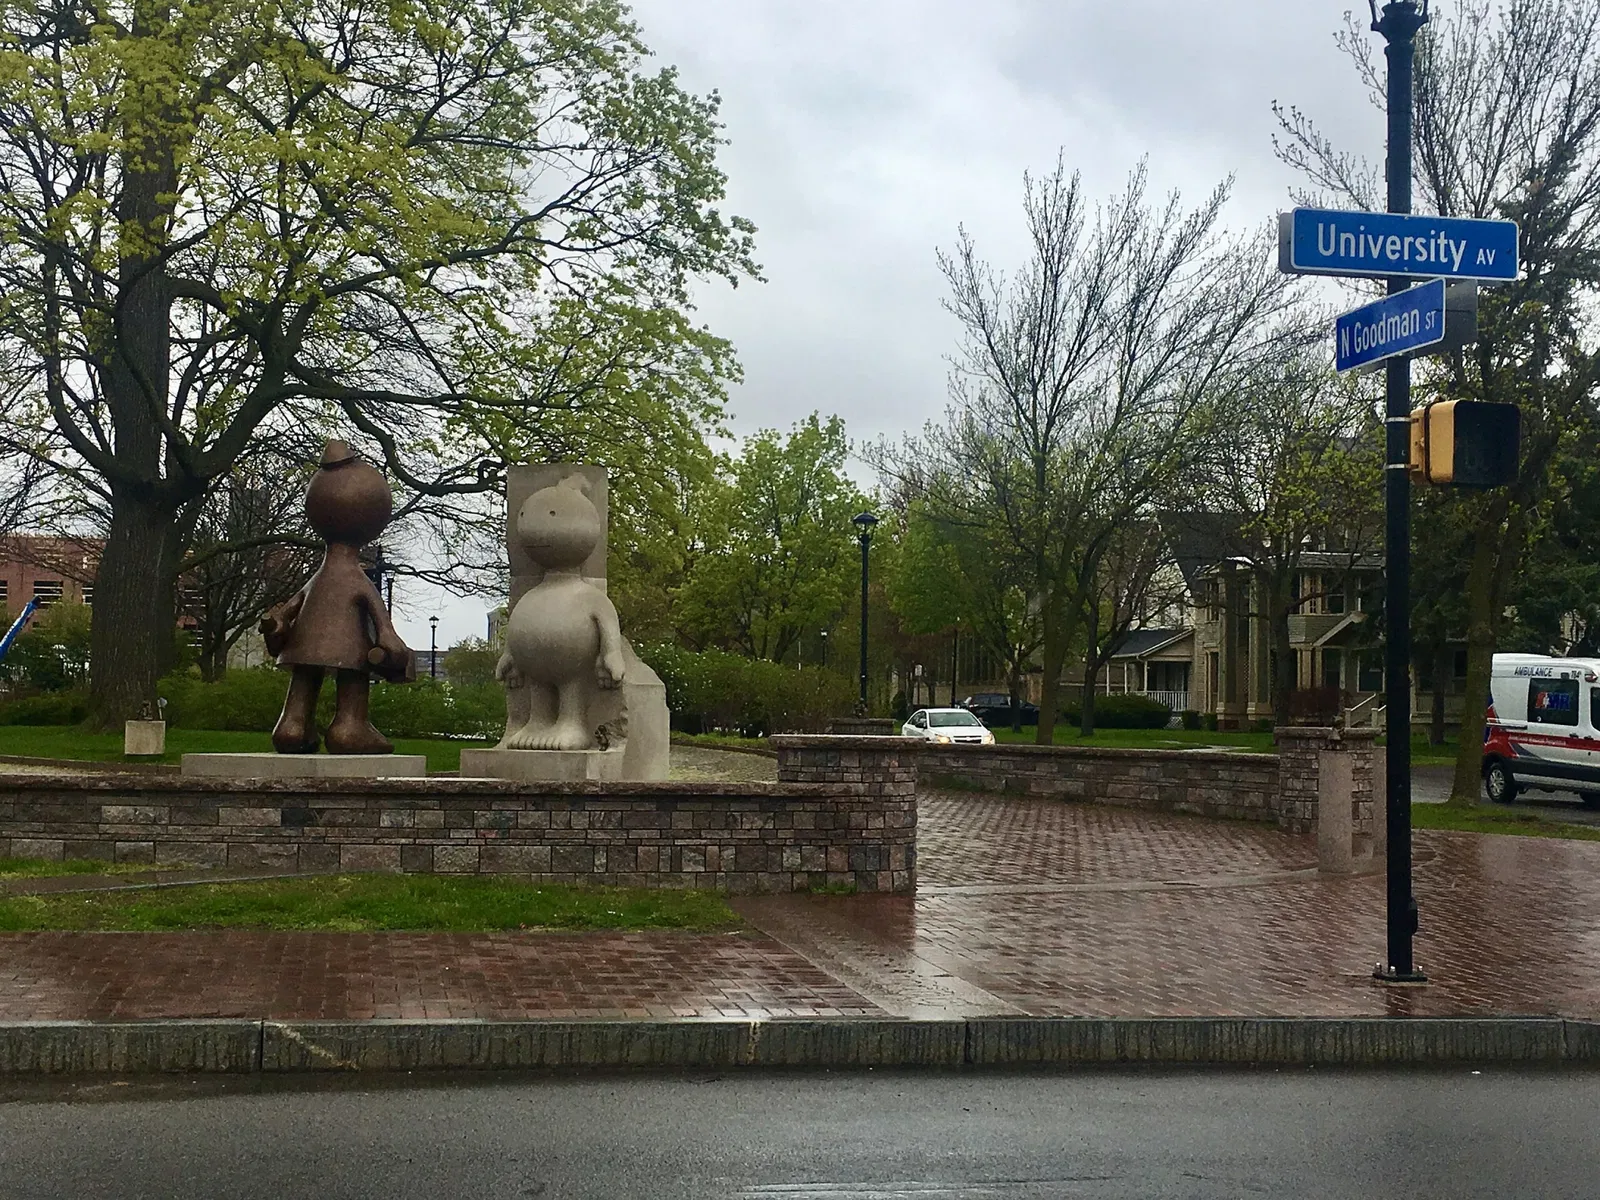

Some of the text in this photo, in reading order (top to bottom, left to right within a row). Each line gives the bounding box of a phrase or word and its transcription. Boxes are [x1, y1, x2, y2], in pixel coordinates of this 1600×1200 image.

[1318, 222, 1496, 272] University AV
[1341, 308, 1437, 359] N Goodman ST
[1514, 666, 1553, 677] AMBULANCE
